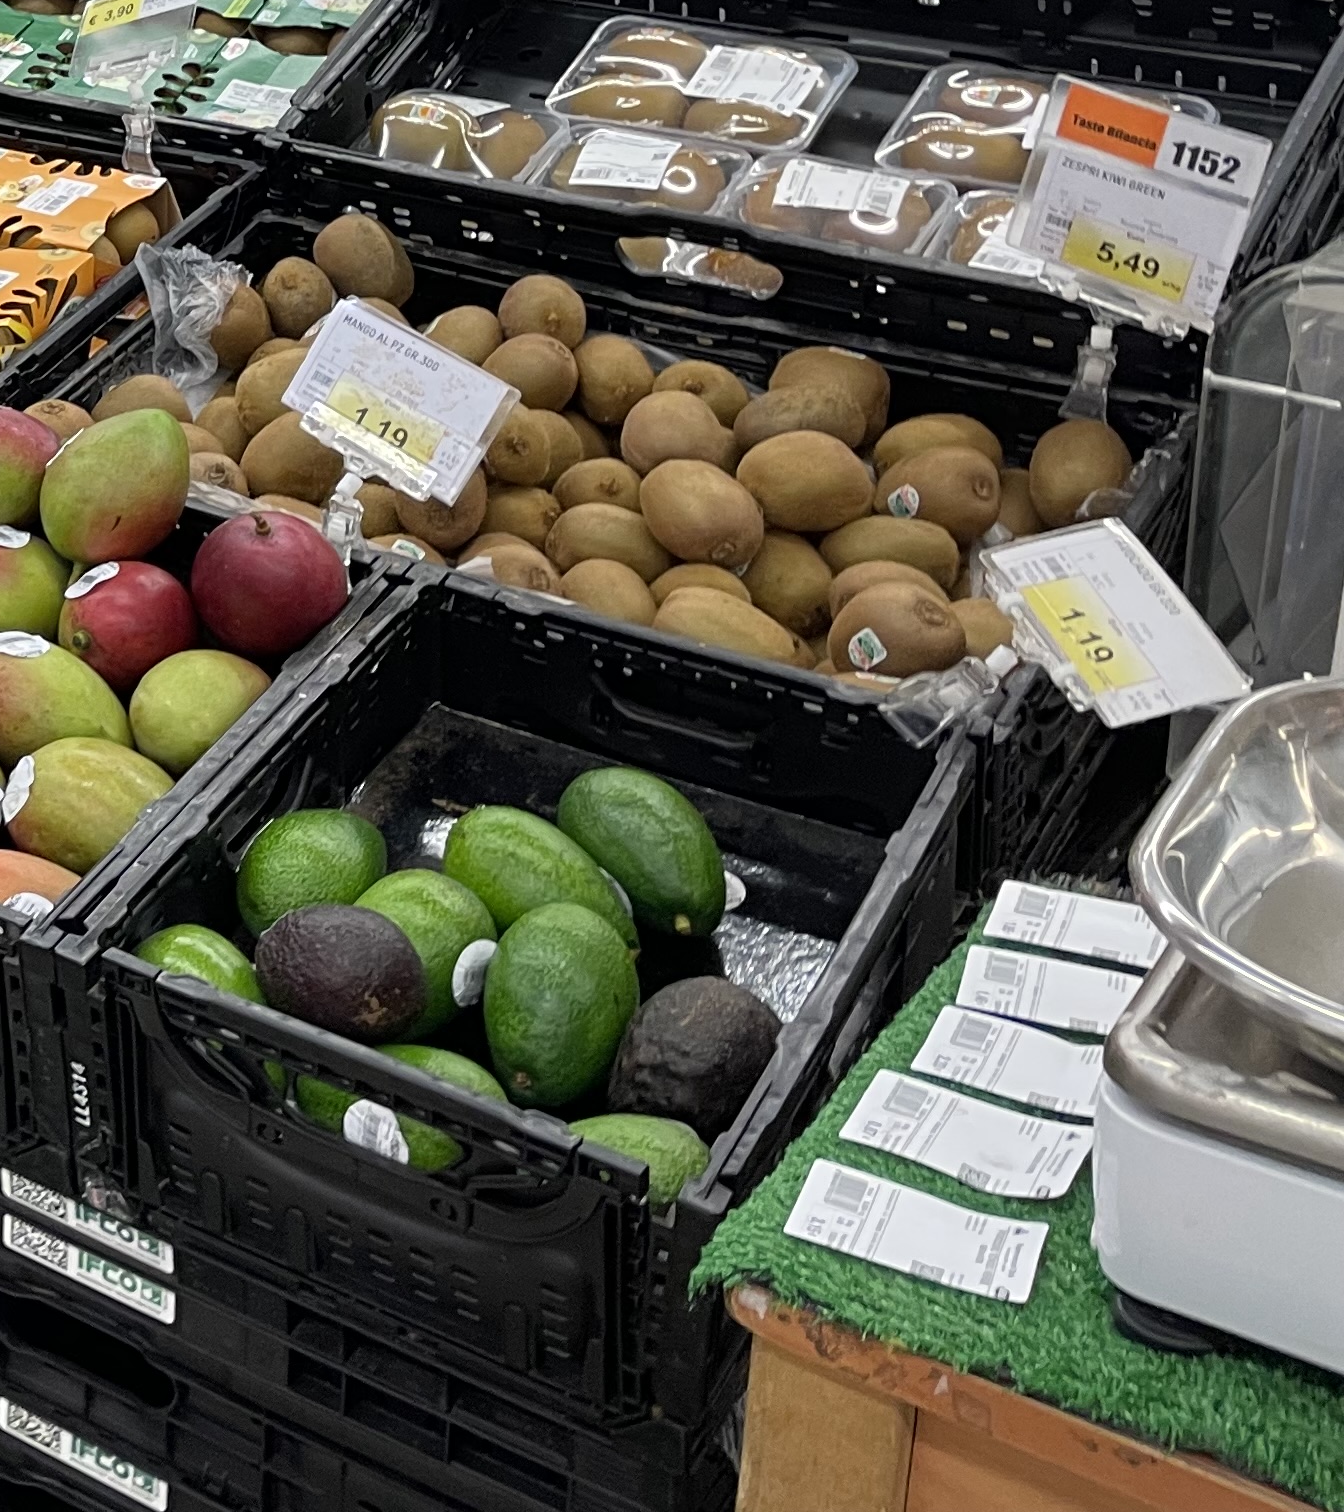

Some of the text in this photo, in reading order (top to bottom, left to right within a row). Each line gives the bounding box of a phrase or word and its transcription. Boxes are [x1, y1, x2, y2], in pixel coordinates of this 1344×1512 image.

[89, 3, 134, 27] € 3,90
[1073, 113, 1242, 184] Tasto Bilancia 1152
[1062, 155, 1166, 201] ZESPRI KIWI GREEN
[1096, 240, 1160, 280] 5,49
[343, 314, 376, 338] MANGO
[376, 331, 390, 348] AL
[391, 339, 405, 355] PZ
[76, 1202, 134, 1243] IFCO
[78, 1250, 138, 1293] IFCO
